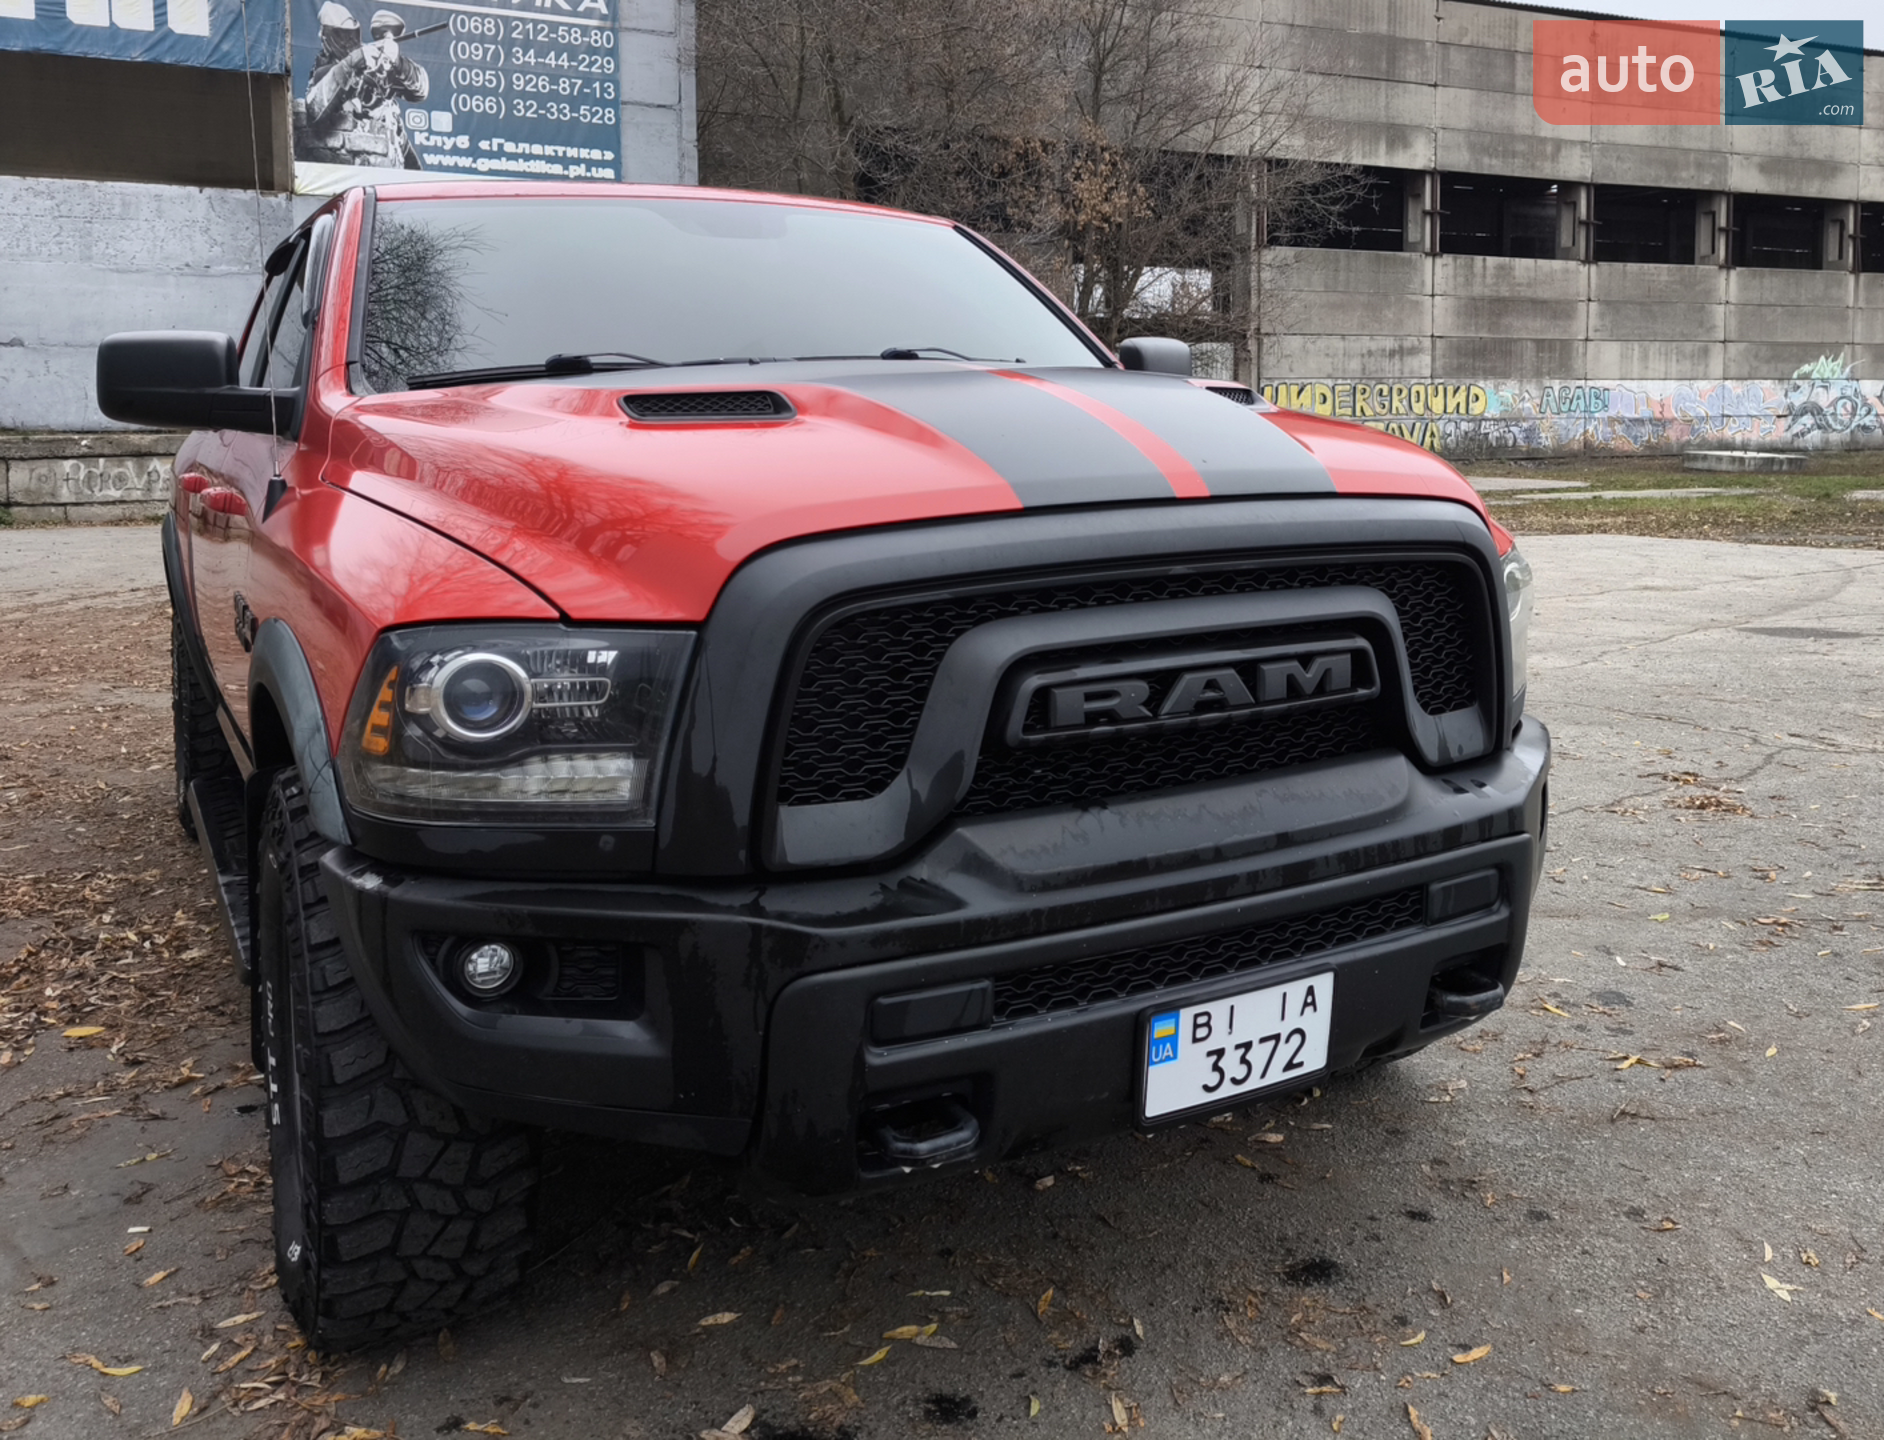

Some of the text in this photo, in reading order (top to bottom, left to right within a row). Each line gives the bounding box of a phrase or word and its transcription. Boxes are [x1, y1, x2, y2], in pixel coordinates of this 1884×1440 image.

[449, 13, 614, 48] (068) 212-58-80
[450, 40, 615, 74] (097) 34-44-229
[450, 66, 615, 100] (095) 926-87-13
[450, 93, 616, 125] (066) 32-33-528
[414, 131, 615, 160] Клуб «Галактика»
[422, 153, 615, 179] www.galaktika.pl.ua
[1050, 653, 1352, 728] RAM
[1192, 1004, 1235, 1044] BI
[1151, 1042, 1175, 1062] UA
[1202, 1027, 1307, 1093] 3372
